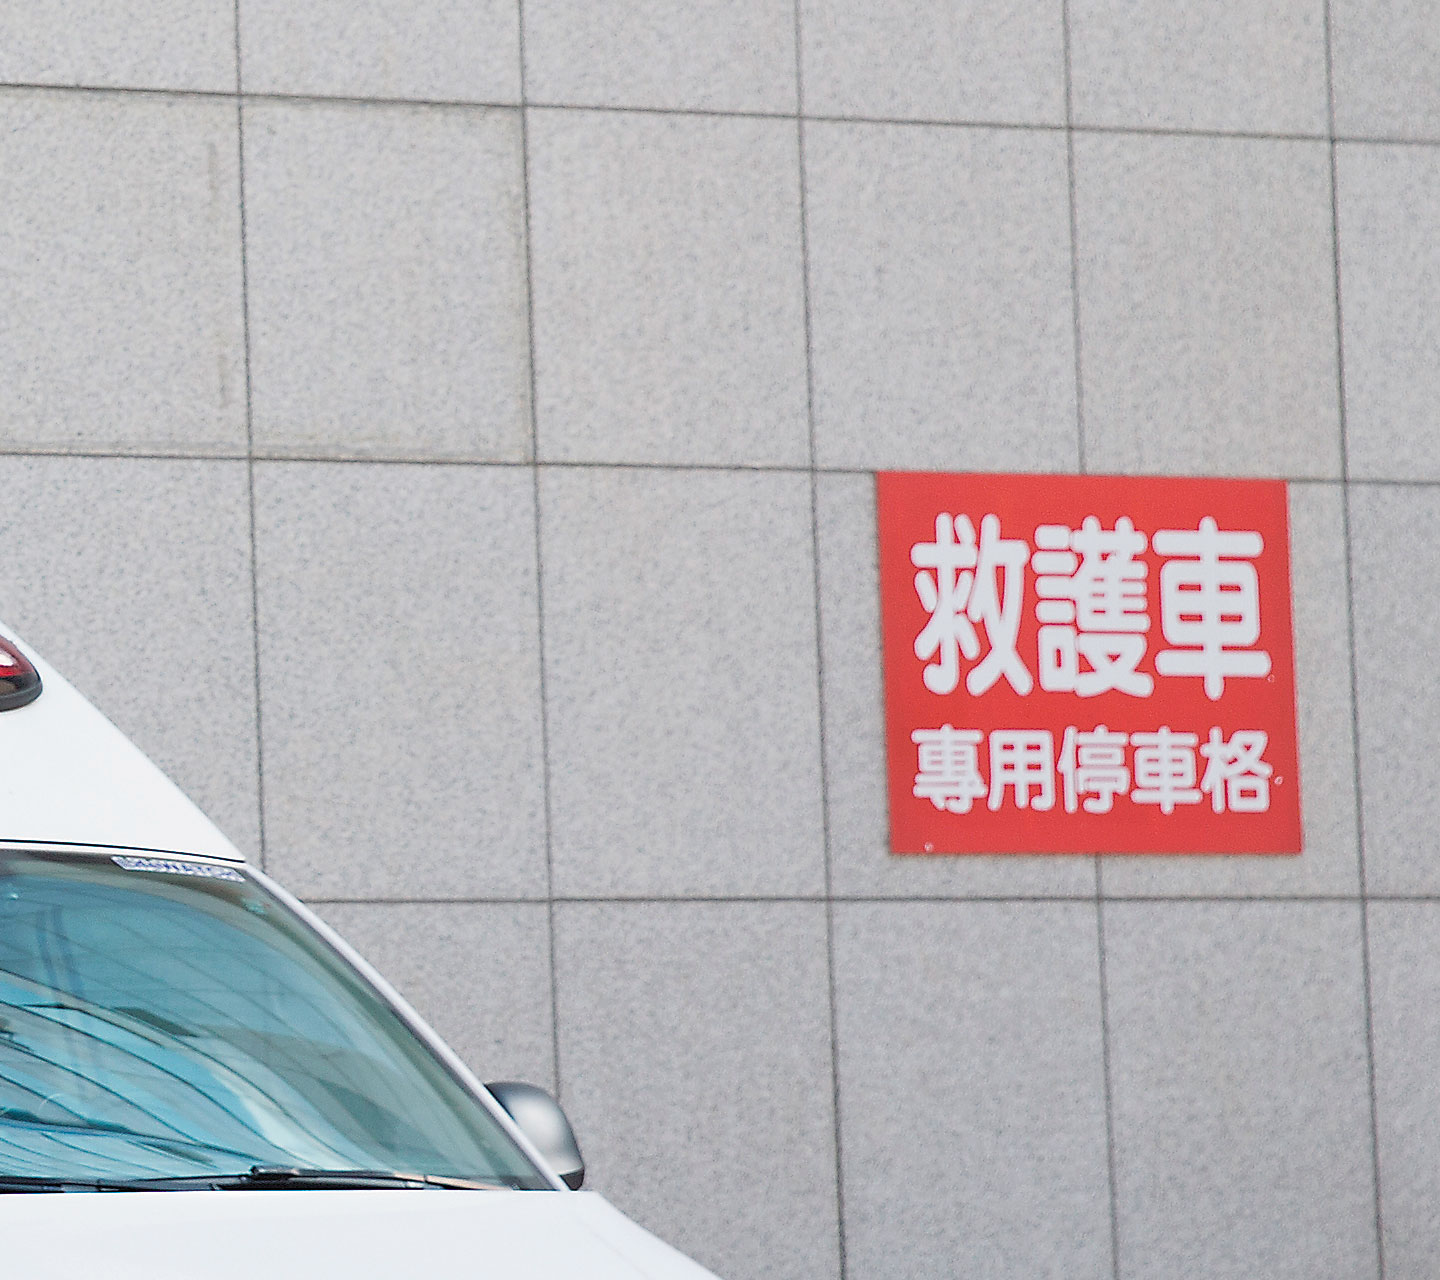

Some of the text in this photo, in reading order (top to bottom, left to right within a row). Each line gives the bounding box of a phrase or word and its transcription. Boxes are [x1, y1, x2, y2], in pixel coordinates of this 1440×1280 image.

[909, 512, 1272, 700] 救護車
[911, 724, 1273, 814] 專用停車格
